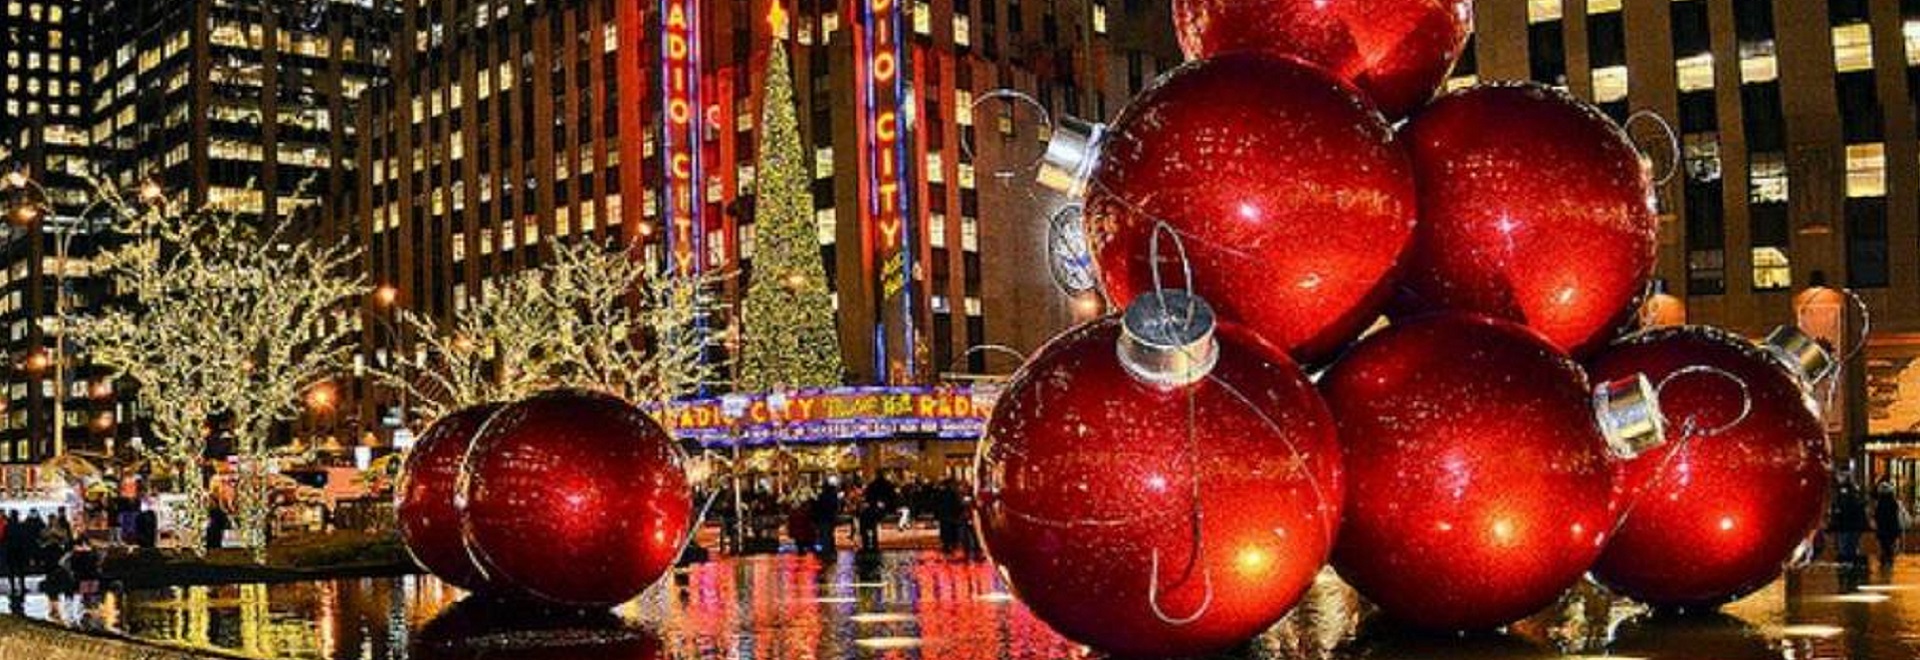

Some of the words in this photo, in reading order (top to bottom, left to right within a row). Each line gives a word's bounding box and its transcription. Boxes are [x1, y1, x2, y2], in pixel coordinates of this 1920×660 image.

[667, 2, 688, 124] ADIO
[671, 152, 694, 277] CITY
[877, 112, 900, 247] CITY
